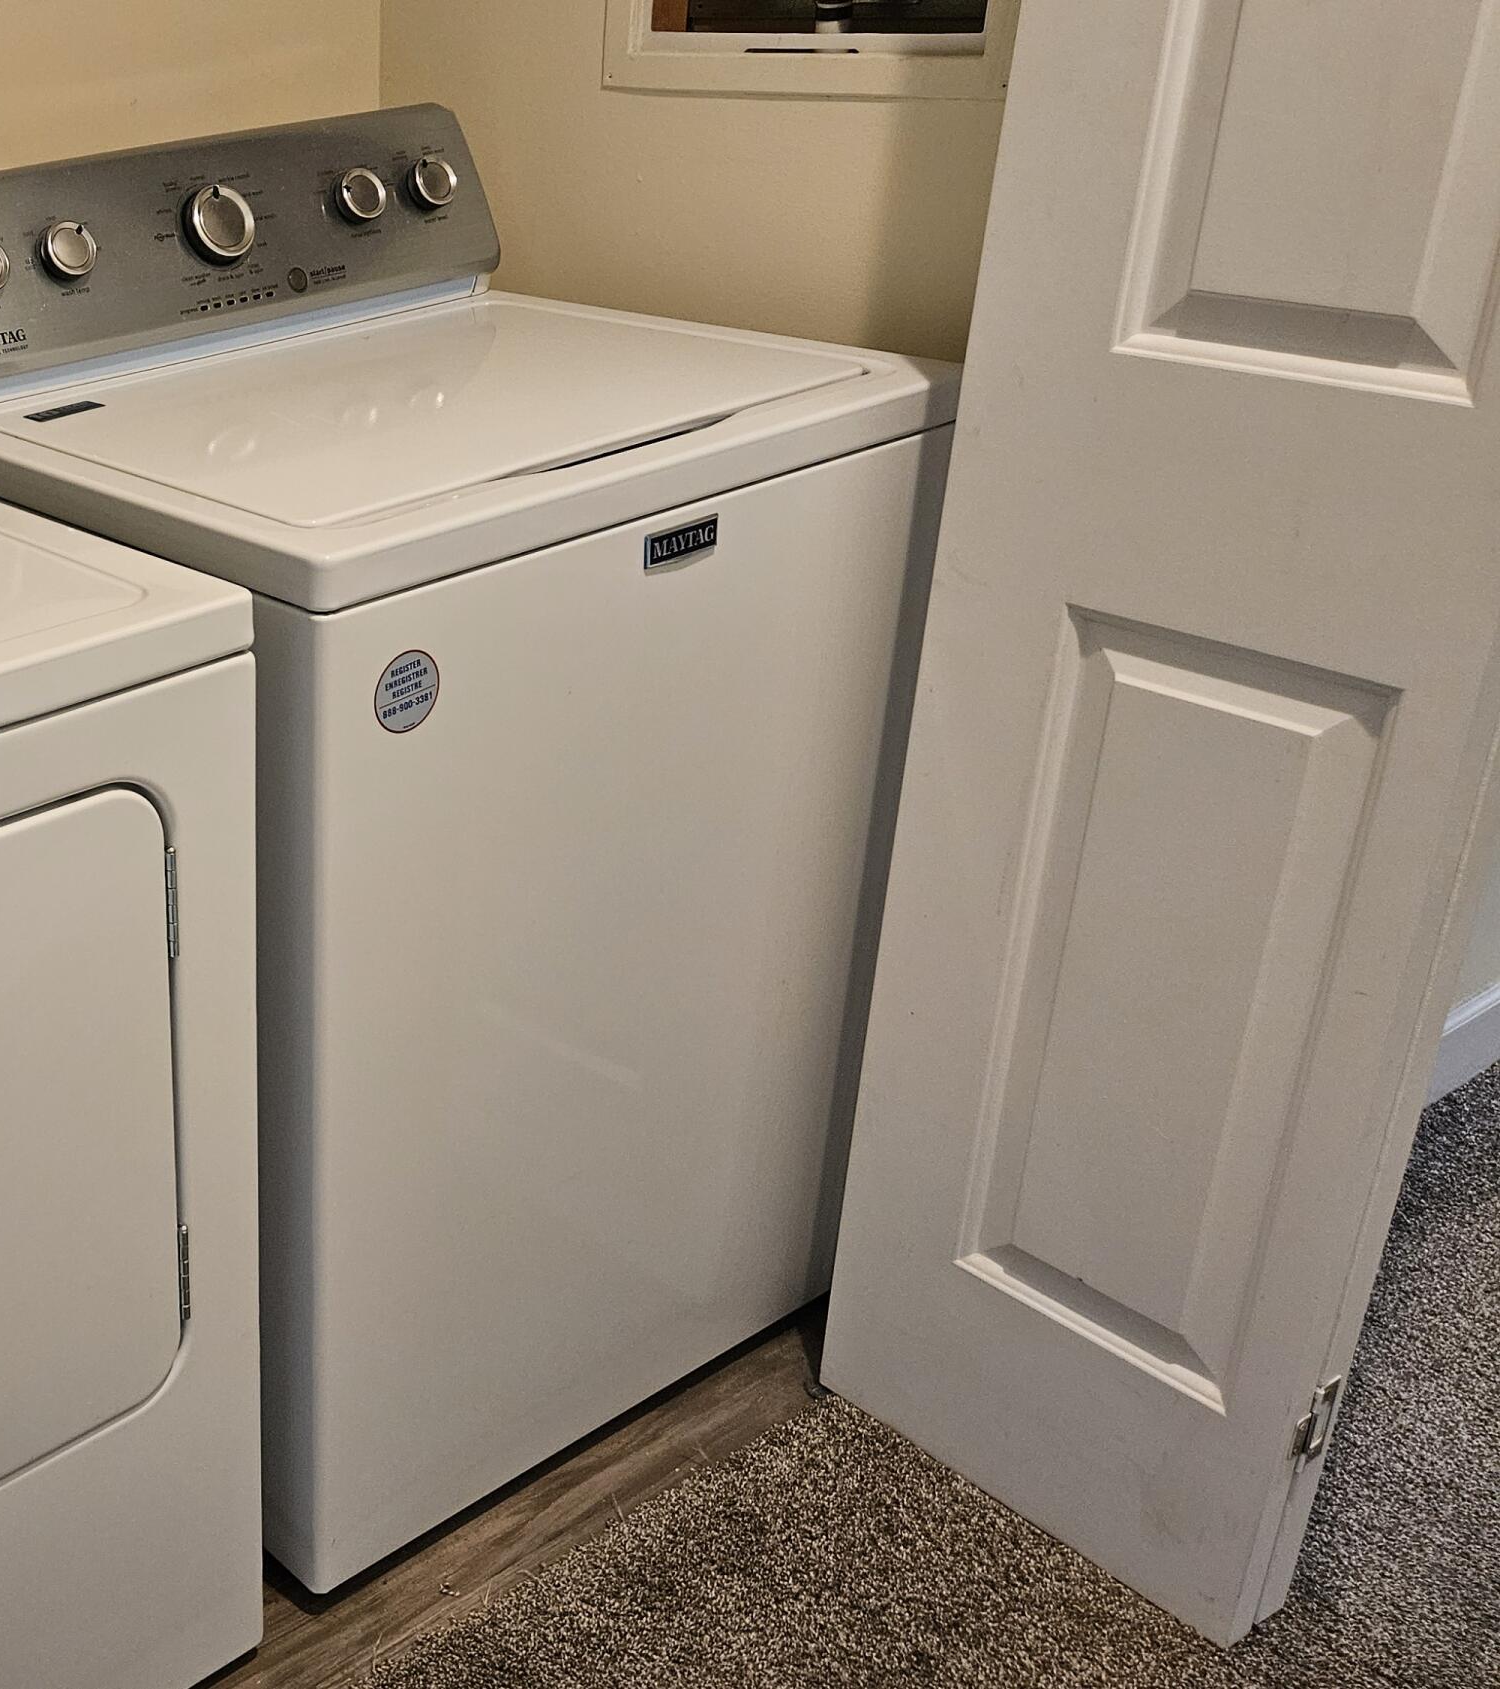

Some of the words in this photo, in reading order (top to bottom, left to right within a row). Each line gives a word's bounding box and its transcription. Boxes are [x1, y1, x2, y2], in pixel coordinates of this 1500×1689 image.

[653, 524, 714, 559] MAYTAG
[385, 667, 428, 691] ENREGISTRER
[390, 658, 421, 678] REGISTER
[392, 680, 422, 699] REGISTRE
[382, 691, 433, 719] 888-900-3381
